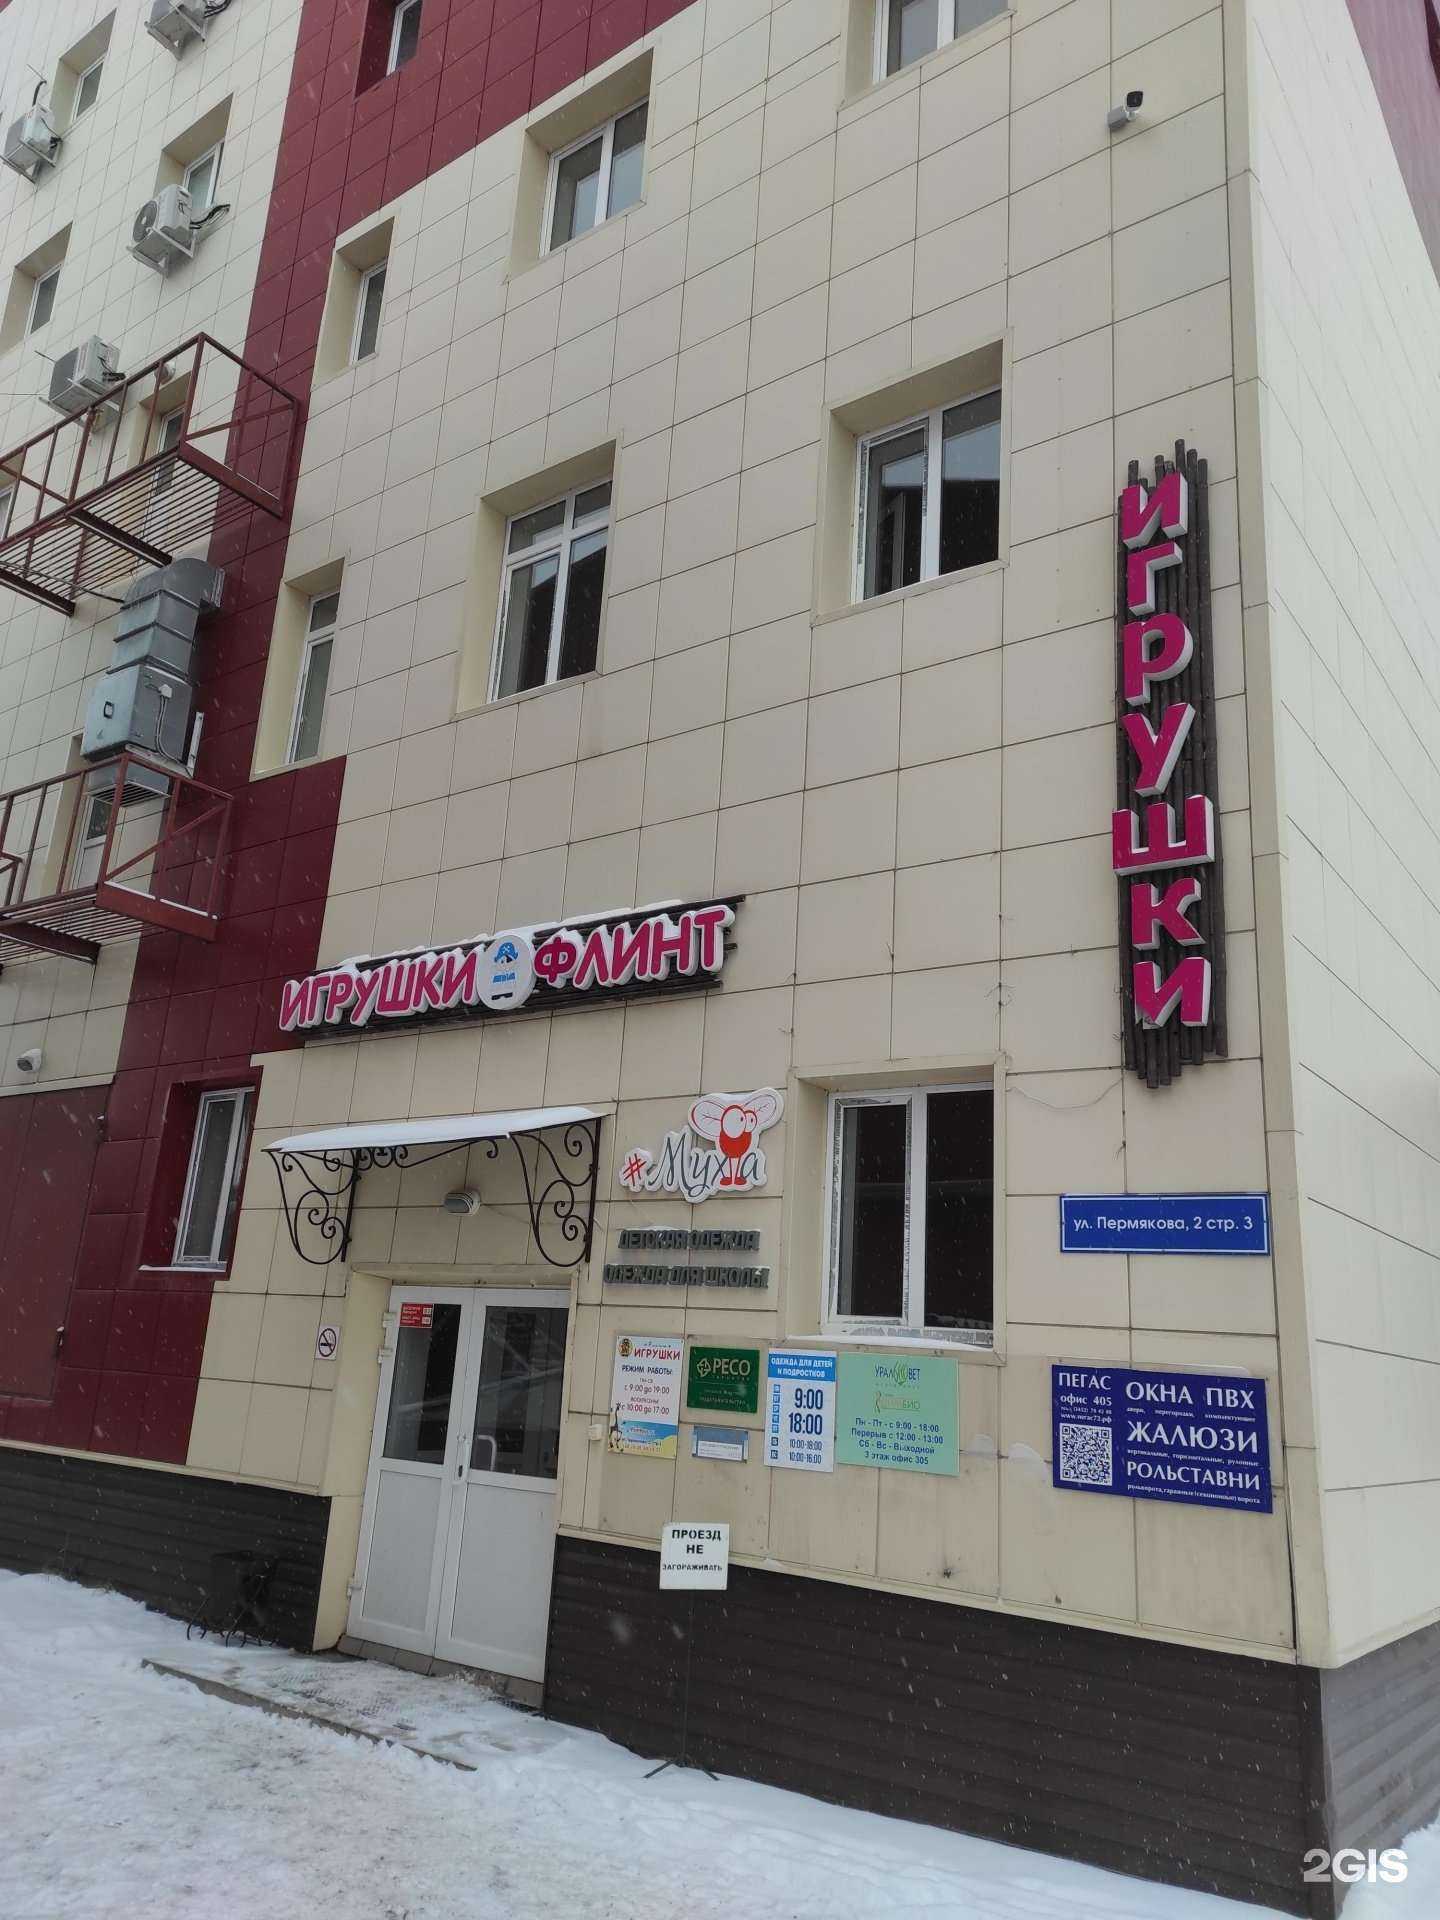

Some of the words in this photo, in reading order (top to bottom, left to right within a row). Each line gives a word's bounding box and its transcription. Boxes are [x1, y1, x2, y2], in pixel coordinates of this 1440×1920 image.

[1112, 470, 1216, 1030] ИГРУШКИ
[279, 945, 479, 1032] ИГРУШКИ
[533, 904, 736, 990] ФЛИНТ
[1073, 1218, 1093, 1232] ул.
[1097, 1216, 1190, 1233] Пермякова,
[1193, 1216, 1203, 1230] 2
[1206, 1218, 1239, 1233] стр.
[1243, 1216, 1254, 1230] 3
[618, 1229, 688, 1250] ДЕТСКАЯ
[689, 1229, 760, 1250] ОДЕЖДА
[604, 1264, 668, 1284] ОДЕЖДА
[668, 1265, 703, 1287] ДЛЯ
[703, 1266, 770, 1289] ШКОЛЫ
[634, 1347, 681, 1361] ИГРУШКИ
[622, 1364, 645, 1373] РЕЖИМ
[647, 1366, 673, 1376] РАБОТЫ
[712, 1357, 751, 1376] РЕСО
[771, 1357, 798, 1367] ОДЕЖДА
[799, 1358, 812, 1367] ДЛЯ
[813, 1358, 833, 1369] ДЕТЕЙ
[783, 1368, 826, 1378] ПОДРОСТКОВ
[1058, 1372, 1112, 1391] ПЕГАС
[794, 1387, 824, 1410] 9:00
[1060, 1392, 1088, 1407] офис
[1092, 1395, 1113, 1407] 405
[1125, 1381, 1194, 1405] ОКНА
[1206, 1387, 1255, 1410] ПВХ
[788, 1412, 823, 1436] 18:00
[855, 1417, 866, 1426] Пн
[872, 1419, 882, 1427] Пт
[895, 1421, 912, 1430] 9:00
[919, 1423, 939, 1433] 18:00
[851, 1427, 887, 1439] Перерыв
[895, 1431, 916, 1442] 12:00
[923, 1435, 944, 1444] 13:00
[1127, 1420, 1258, 1454] ЖАЛЮЗИ
[858, 1439, 869, 1448] Сб
[876, 1440, 887, 1450] Вс
[893, 1442, 935, 1454] Выходной
[864, 1450, 869, 1458] 3
[871, 1453, 890, 1461] этаж
[891, 1454, 913, 1464] офис
[915, 1456, 929, 1465] 305
[1127, 1461, 1260, 1491] РОЛЬСТАВНИ
[671, 1529, 722, 1542] ПРОЕЗД
[686, 1544, 704, 1555] НЕ
[662, 1563, 723, 1572] ЗАГОРАЖИВАТЬ
